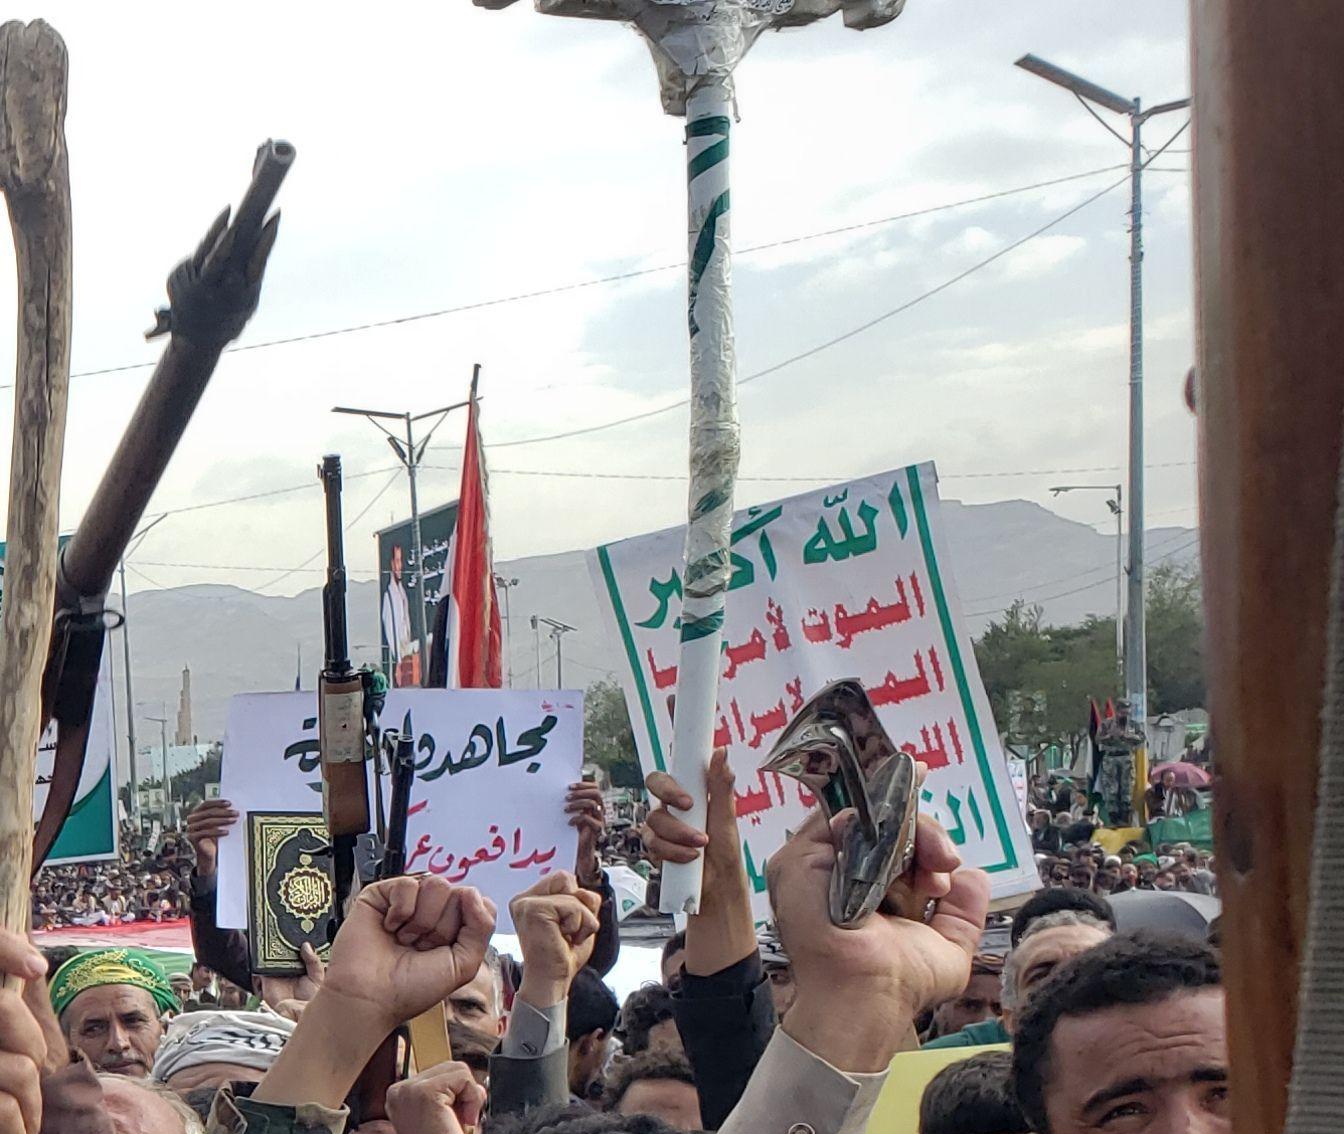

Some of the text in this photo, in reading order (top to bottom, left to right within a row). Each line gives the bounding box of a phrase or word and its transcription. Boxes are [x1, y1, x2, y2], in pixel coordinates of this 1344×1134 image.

[803, 482, 910, 566] الله
[646, 570, 926, 692] الموت لأمرا
[865, 644, 946, 707] الم
[899, 716, 964, 772] اللع
[427, 825, 557, 884] يدافعون
